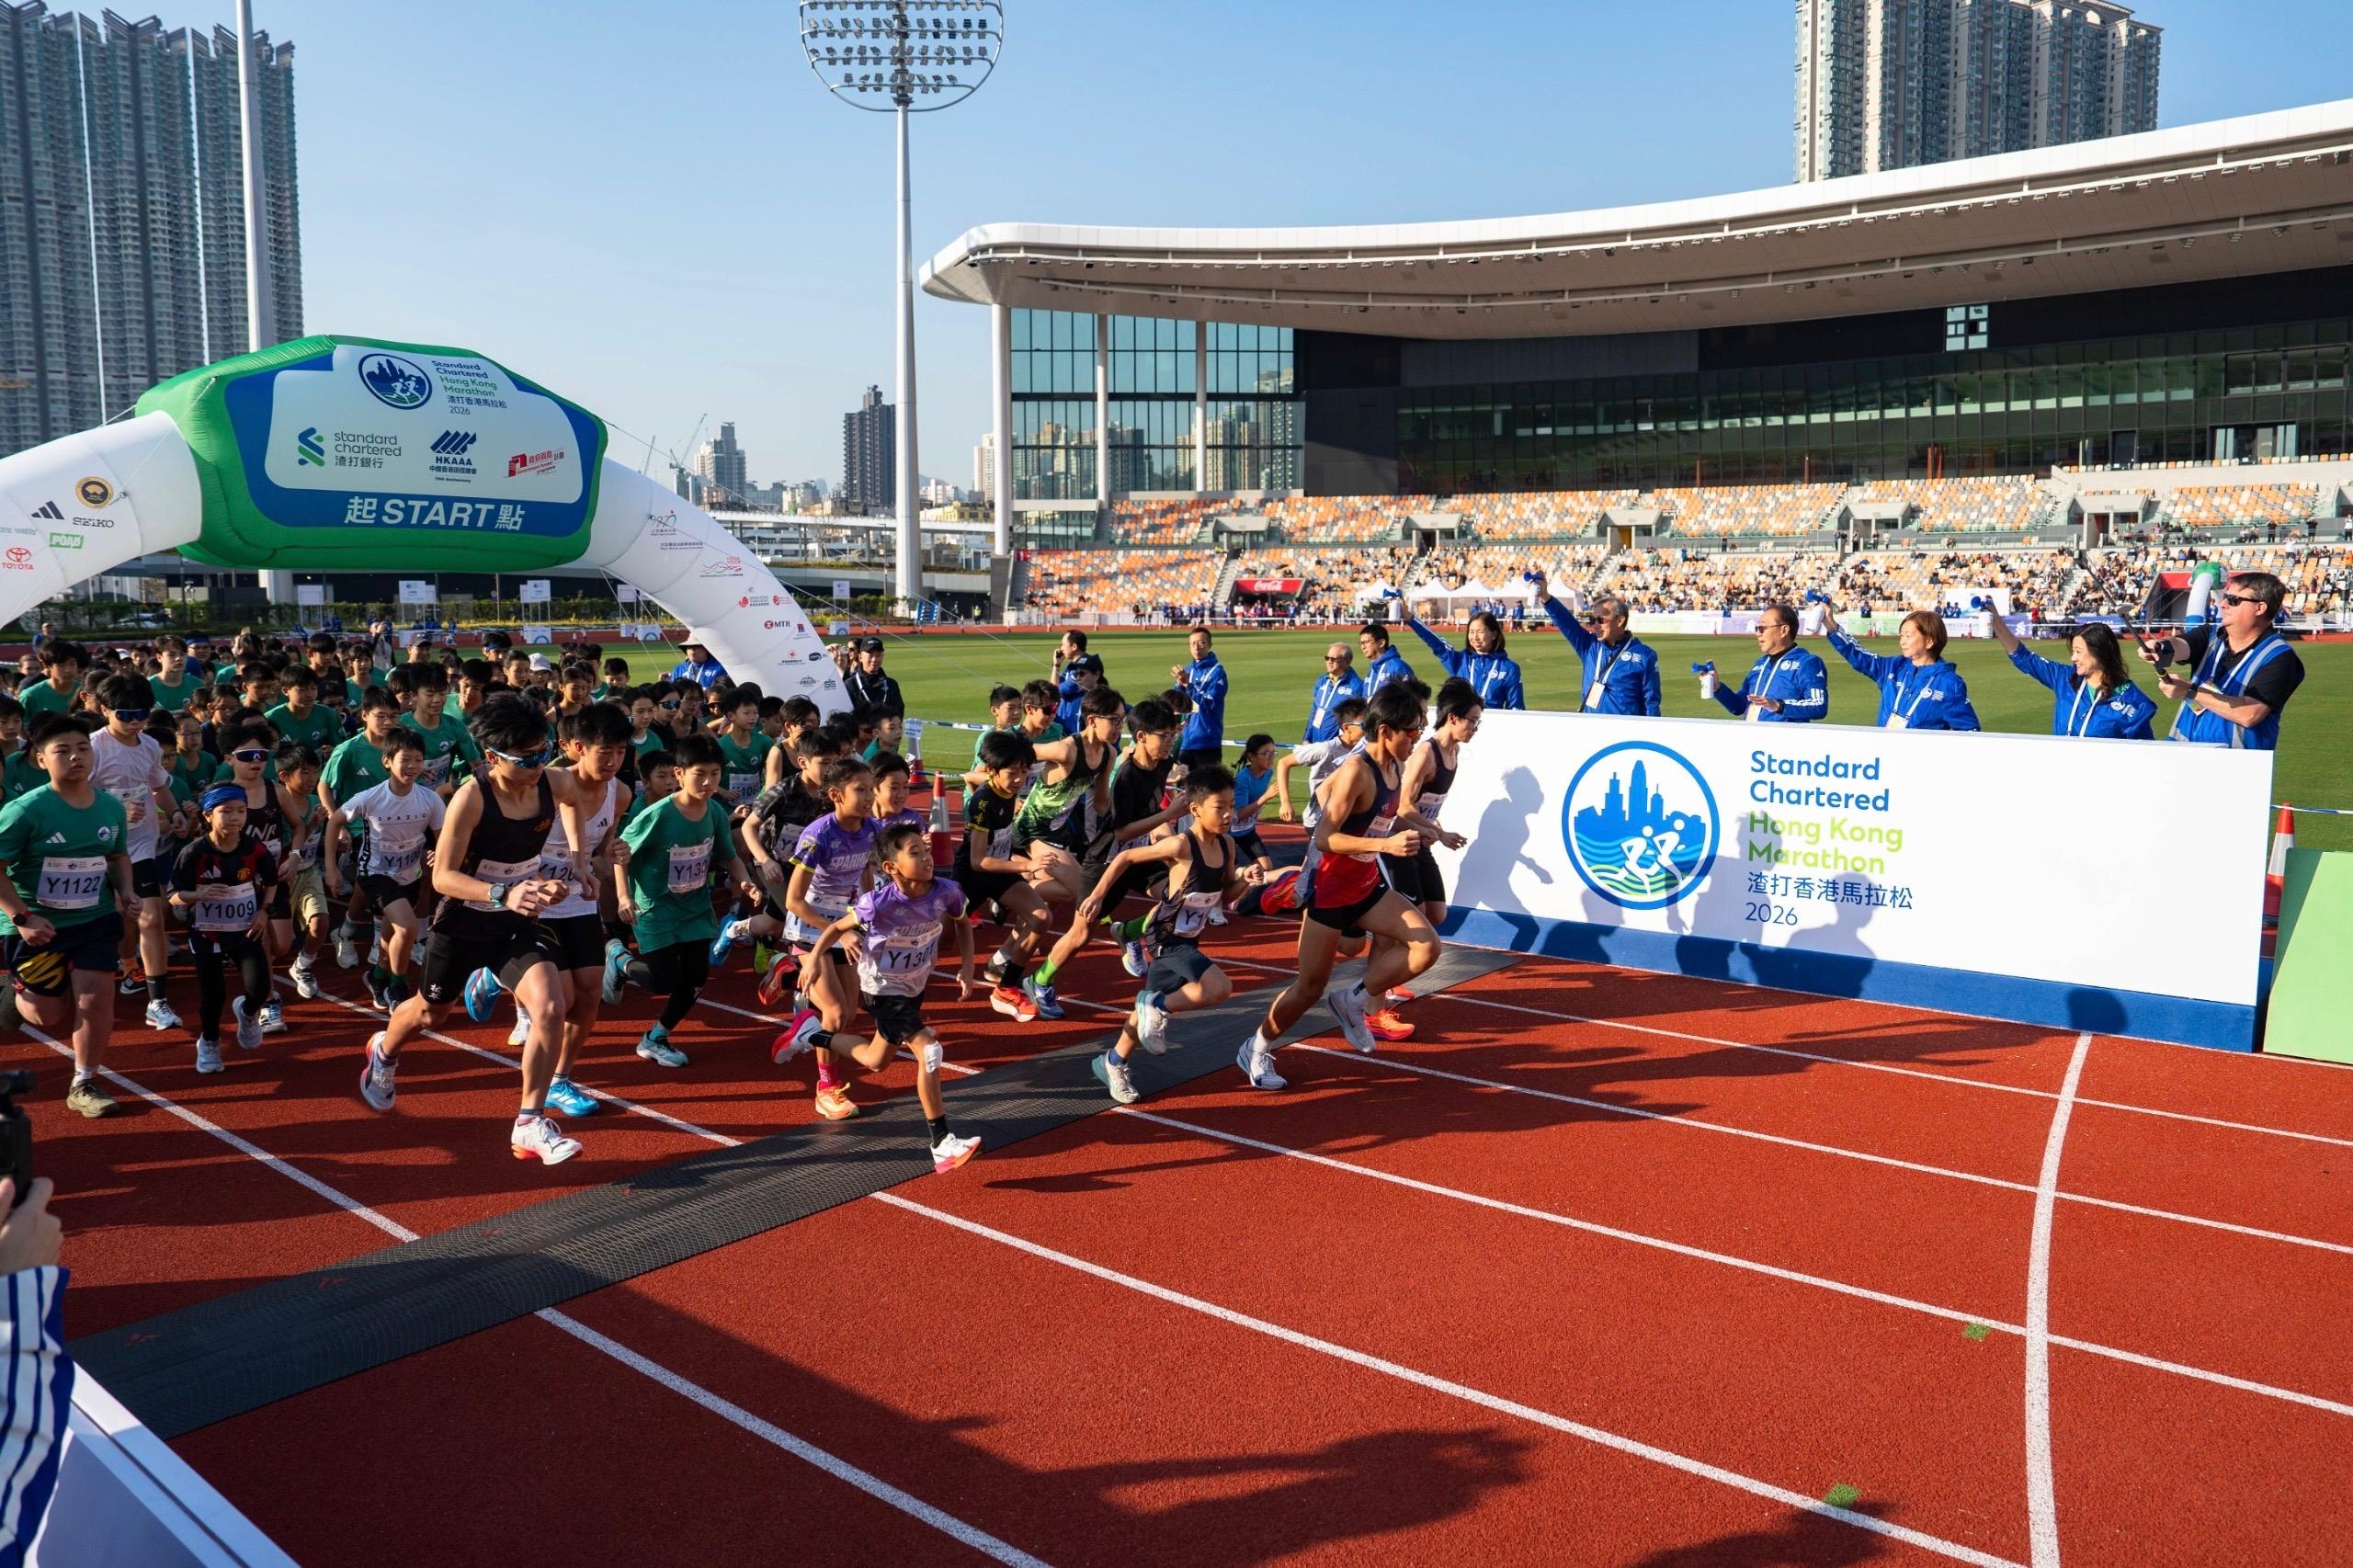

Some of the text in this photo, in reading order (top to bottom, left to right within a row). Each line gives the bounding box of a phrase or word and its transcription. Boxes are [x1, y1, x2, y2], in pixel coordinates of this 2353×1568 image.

[431, 360, 481, 370] Standard
[436, 368, 488, 379] Chartered
[440, 376, 497, 390] Hong Kong
[443, 385, 494, 397] Marathon
[449, 405, 471, 415] 2026
[335, 431, 397, 445] standard
[335, 442, 402, 457] chartered
[335, 455, 384, 469] 渣打銀行
[436, 456, 472, 466] HKAAA
[344, 496, 526, 530] 起 START 點
[73, 517, 114, 528] SEIKO
[1, 562, 34, 571] TOYOTA
[1750, 750, 1881, 780] Standard
[1749, 780, 1890, 812] Chartered
[1749, 811, 1904, 852] Hong Kong
[1748, 840, 1885, 874] Marathon
[47, 876, 100, 894] Y1122
[1747, 871, 1913, 910] 渣打香港馬拉松
[202, 901, 254, 919] Y1009
[1745, 902, 1799, 926] 2026
